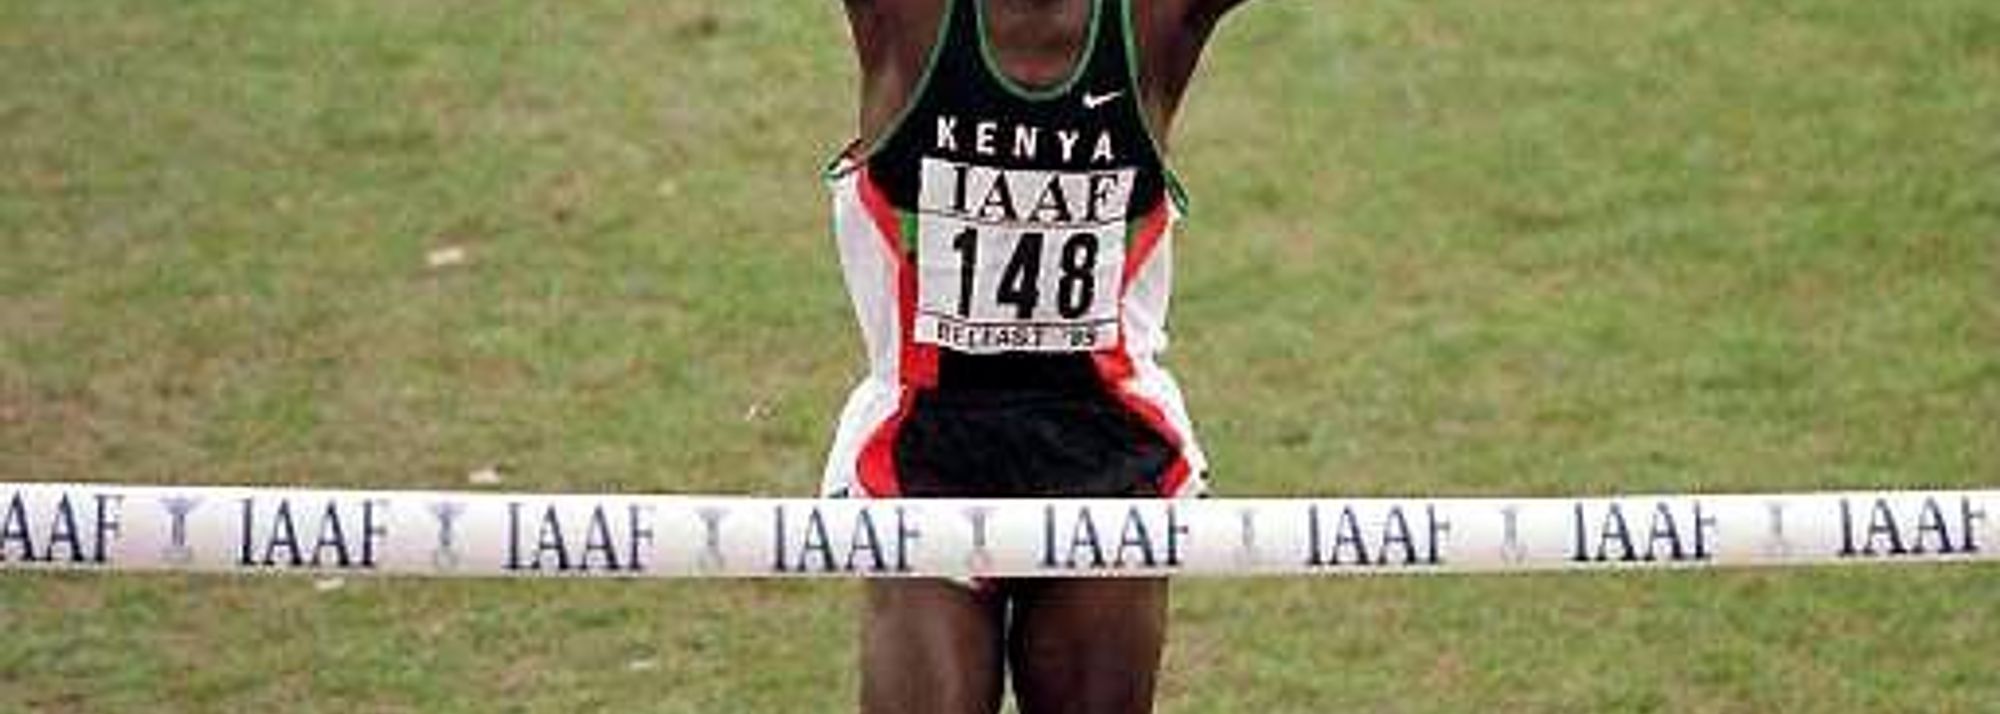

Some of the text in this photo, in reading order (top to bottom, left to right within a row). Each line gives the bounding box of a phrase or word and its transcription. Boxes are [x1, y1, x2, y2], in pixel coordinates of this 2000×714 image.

[936, 114, 1115, 164] KENYA
[952, 166, 1119, 223] IAAF
[953, 227, 1099, 319] 148
[0, 490, 1986, 572] AAF IAAF IAAF IAAF IAAF IAAF IAAF IAAF
